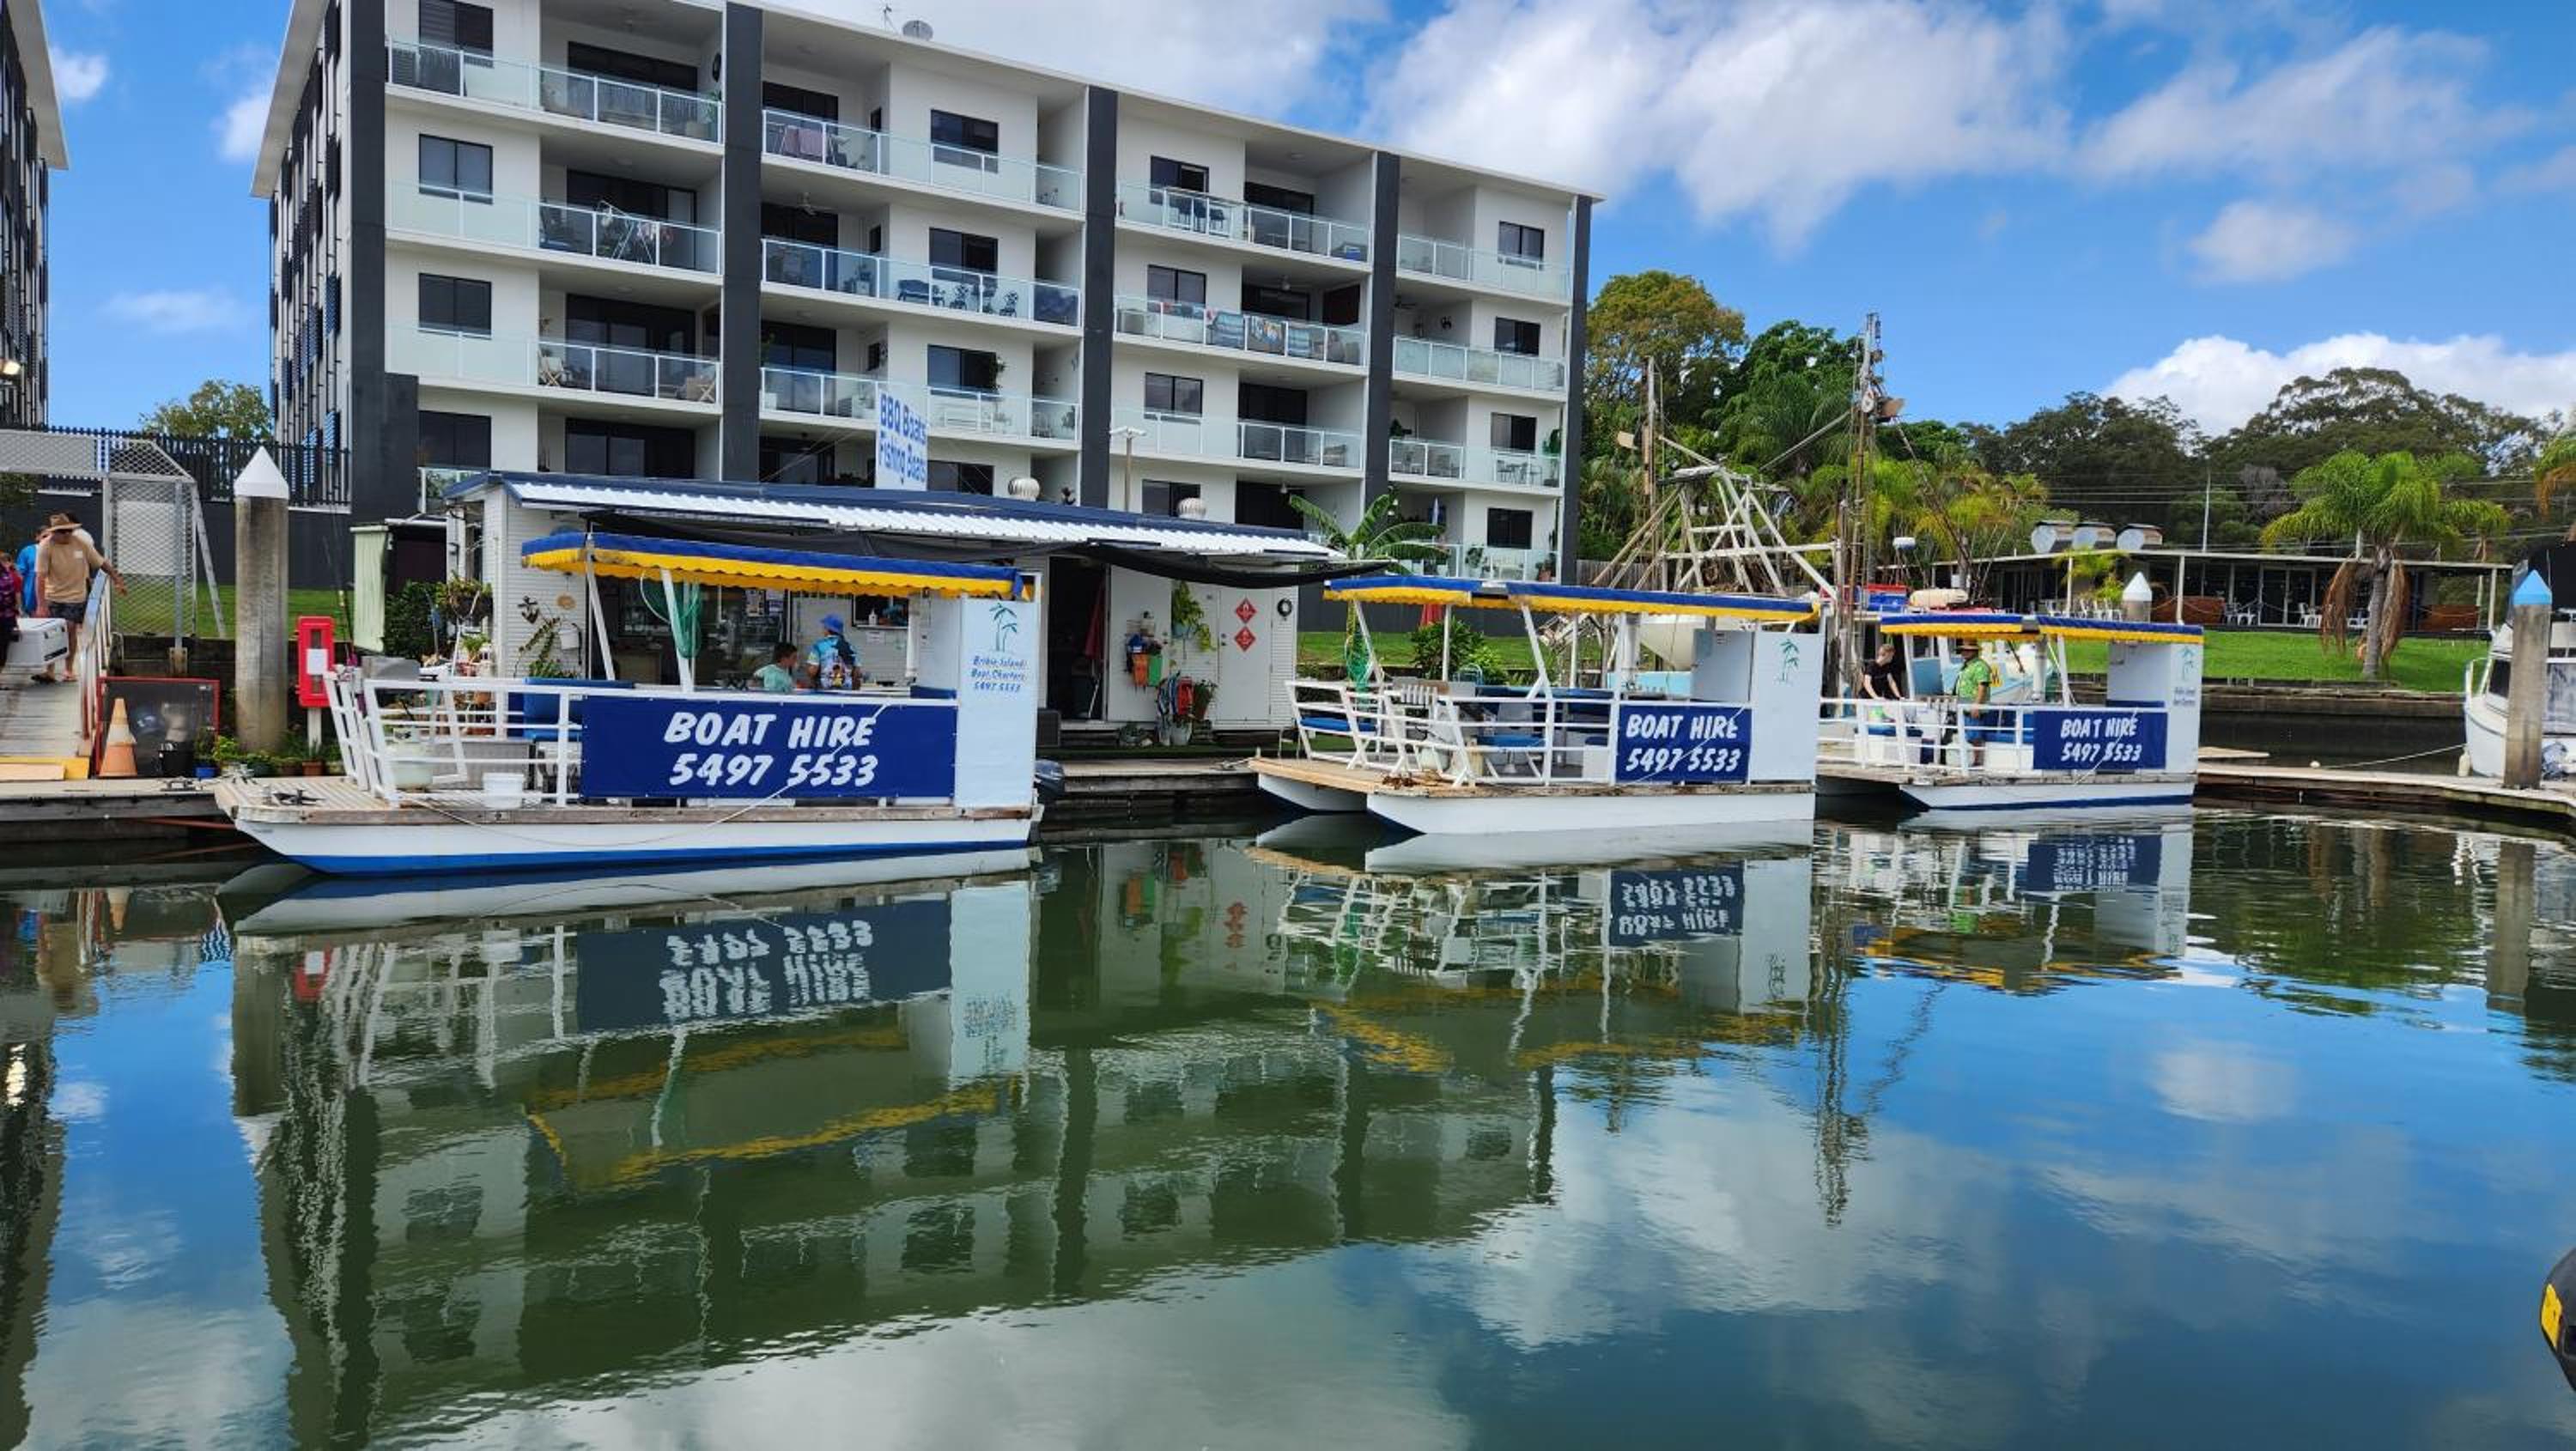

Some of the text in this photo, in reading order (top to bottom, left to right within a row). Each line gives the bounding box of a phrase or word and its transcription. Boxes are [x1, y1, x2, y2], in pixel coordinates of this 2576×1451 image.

[880, 393, 927, 445] BBQ Boats
[878, 430, 927, 485] Fishing Boats
[664, 712, 877, 749] BOAT HIRE
[1625, 714, 1739, 739] BOAT HIRE
[2061, 717, 2138, 738] BOAT HIRE
[1625, 748, 1741, 772] 5497 5533
[2061, 742, 2142, 762] 5497 5533
[669, 753, 878, 786] 5497 5533
